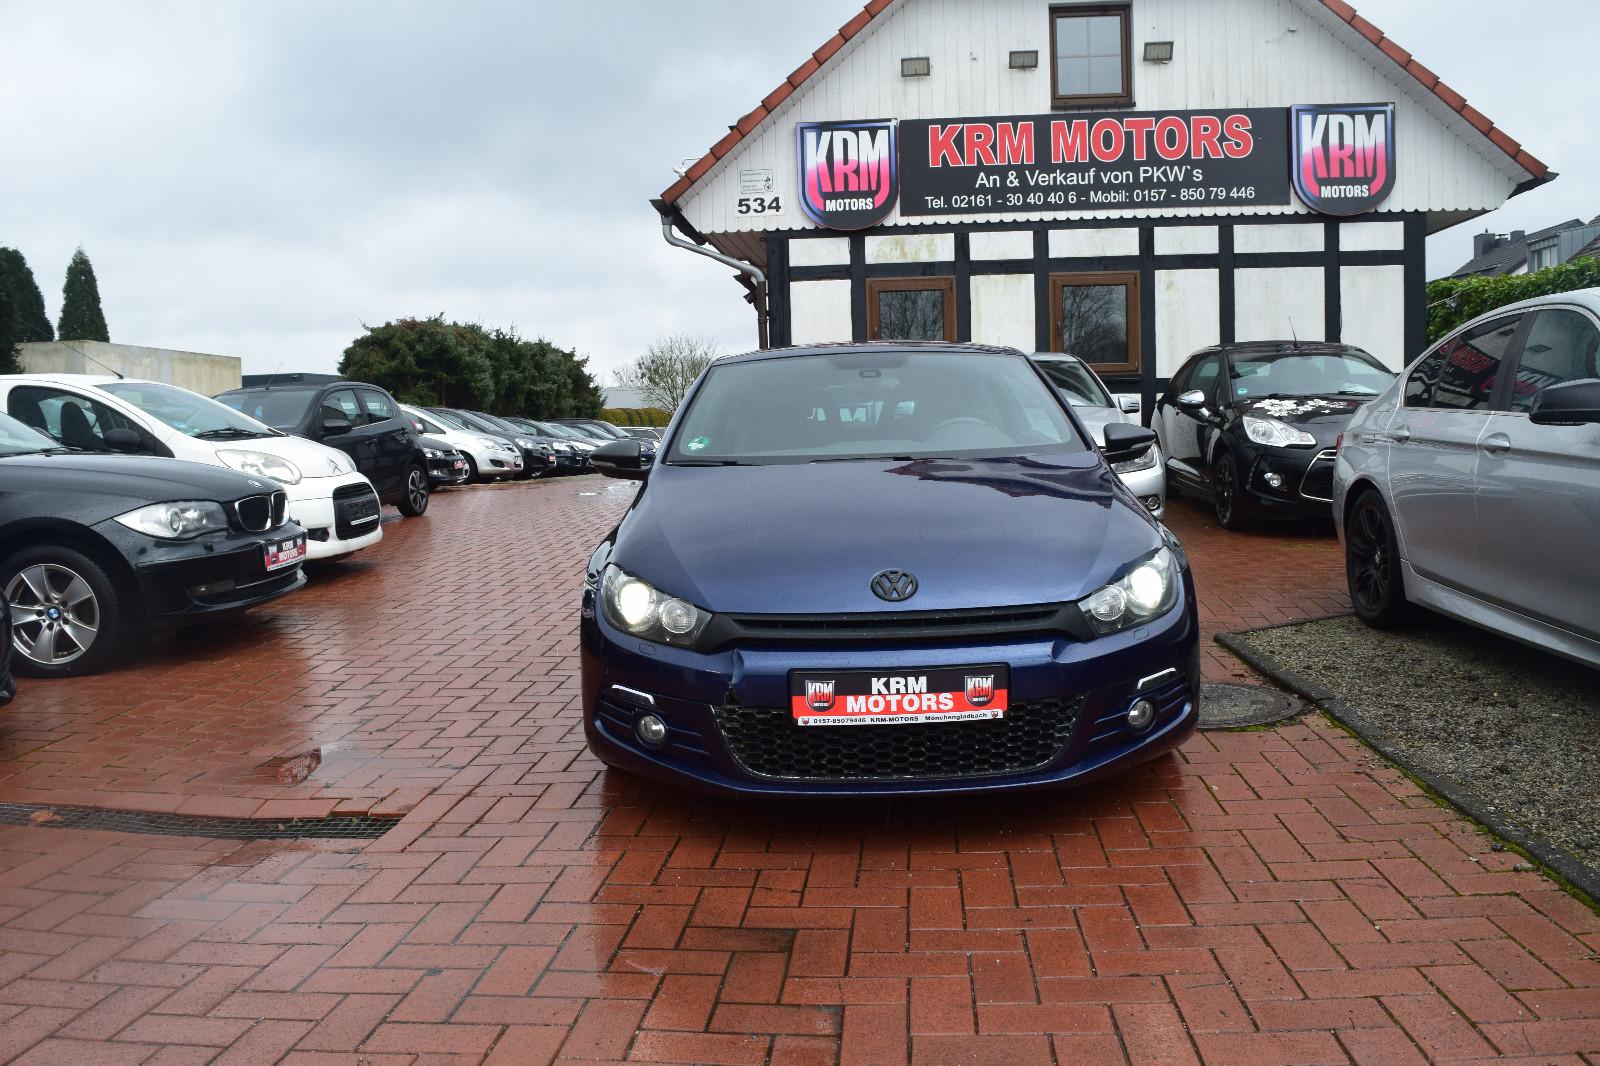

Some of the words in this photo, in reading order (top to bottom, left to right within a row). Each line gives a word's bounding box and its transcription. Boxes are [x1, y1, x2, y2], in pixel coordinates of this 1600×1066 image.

[929, 121, 1034, 167] KRM
[1051, 115, 1253, 163] MOTORS
[1302, 114, 1386, 197] KRM
[805, 130, 889, 209] KRM
[975, 172, 999, 188] An
[1007, 171, 1019, 187] &
[1025, 168, 1095, 186] Verkauf
[1101, 169, 1132, 184] von
[926, 196, 948, 209] Tel.
[952, 194, 991, 208] 02161
[1007, 194, 1022, 206] 30
[1026, 193, 1043, 205] 40
[1048, 192, 1065, 204] 40
[1068, 192, 1076, 204] 6
[1090, 190, 1129, 203] Mobil:
[1134, 189, 1166, 202] 0157
[1180, 188, 1205, 200] 850
[1209, 187, 1226, 199] 79
[1230, 186, 1255, 199] 446
[1320, 185, 1369, 198] MOTORS
[738, 197, 781, 214] 534
[825, 198, 873, 211] MOTORS
[872, 677, 927, 694] KRM
[847, 693, 954, 713] MOTORS
